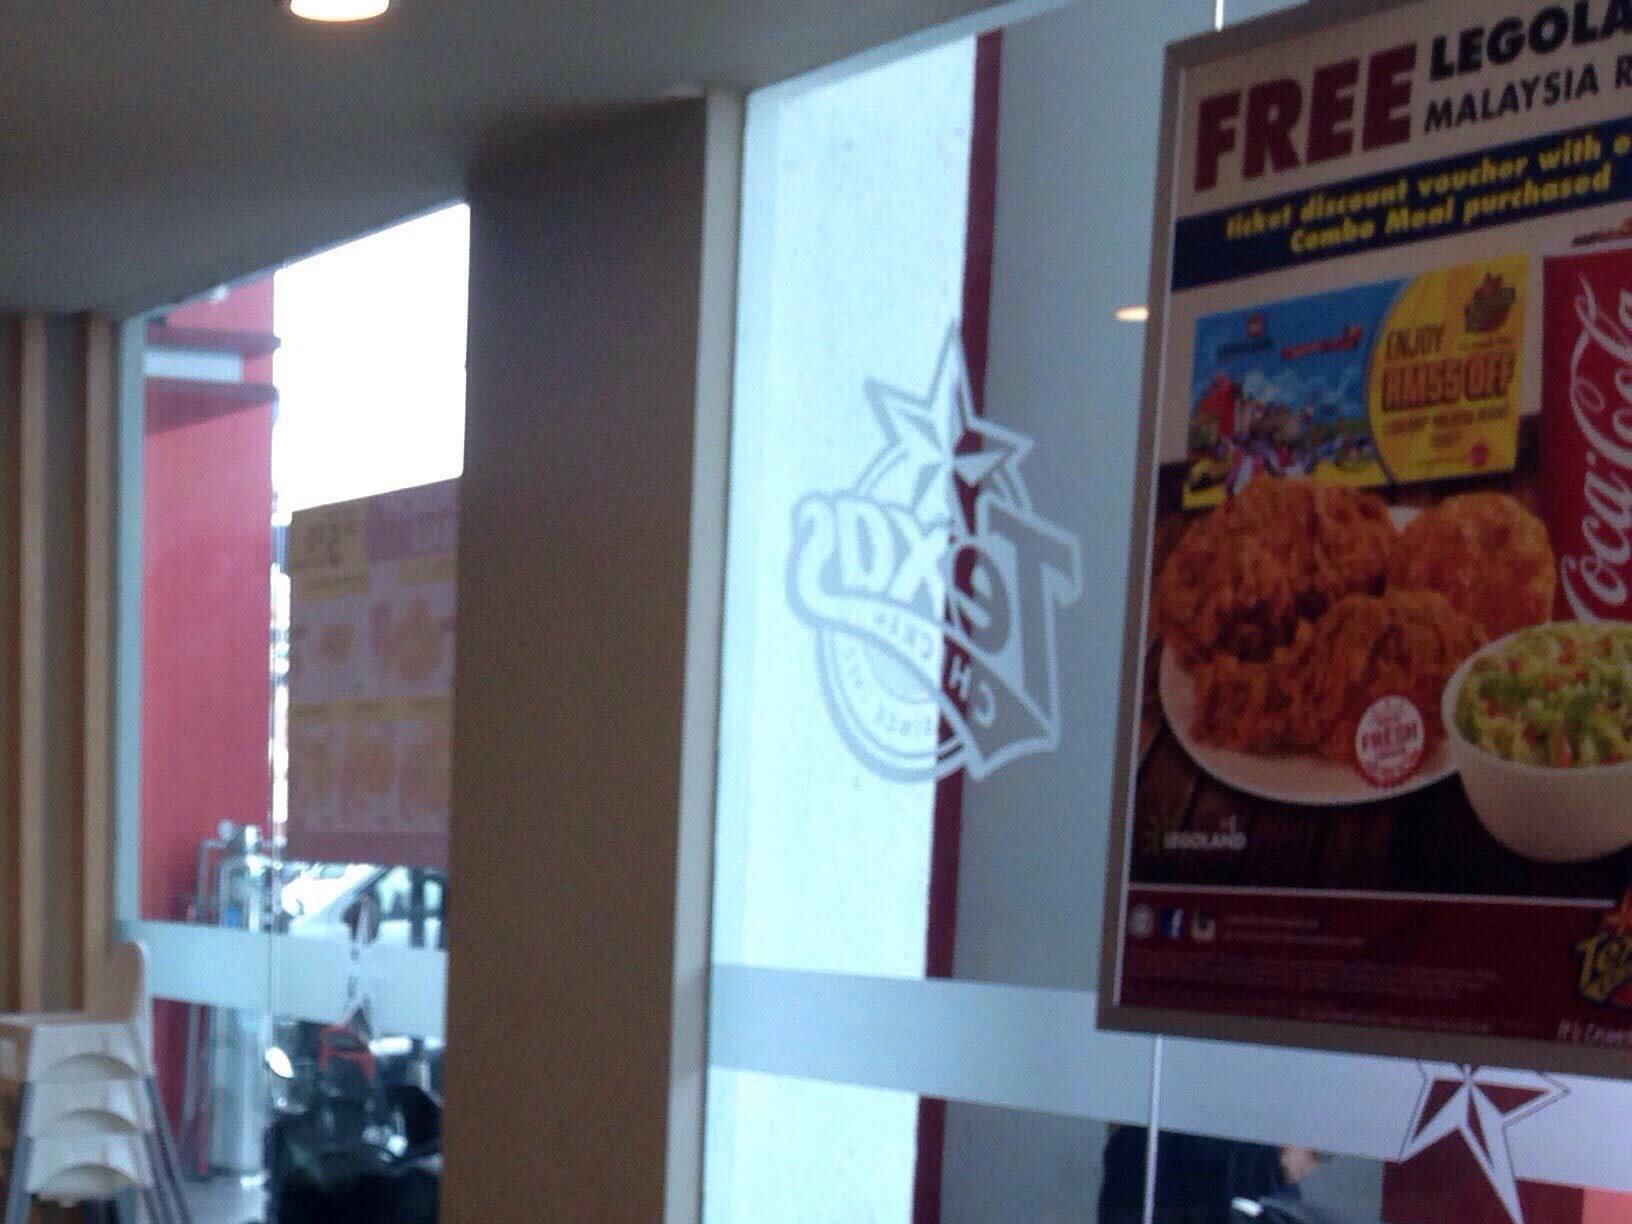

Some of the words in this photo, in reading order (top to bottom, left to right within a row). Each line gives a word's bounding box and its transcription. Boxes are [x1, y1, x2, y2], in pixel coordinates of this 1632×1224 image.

[1193, 42, 1418, 192] FREE
[1424, 63, 1599, 133] MALAYSIA
[1291, 218, 1375, 254] Combo
[1384, 198, 1455, 234] Meal
[1463, 163, 1612, 222] purchased
[1300, 180, 1408, 223] discount
[1418, 157, 1528, 197] voucher
[1539, 134, 1602, 169] with
[1385, 321, 1445, 360] ENJOY
[1464, 348, 1517, 401] OFF
